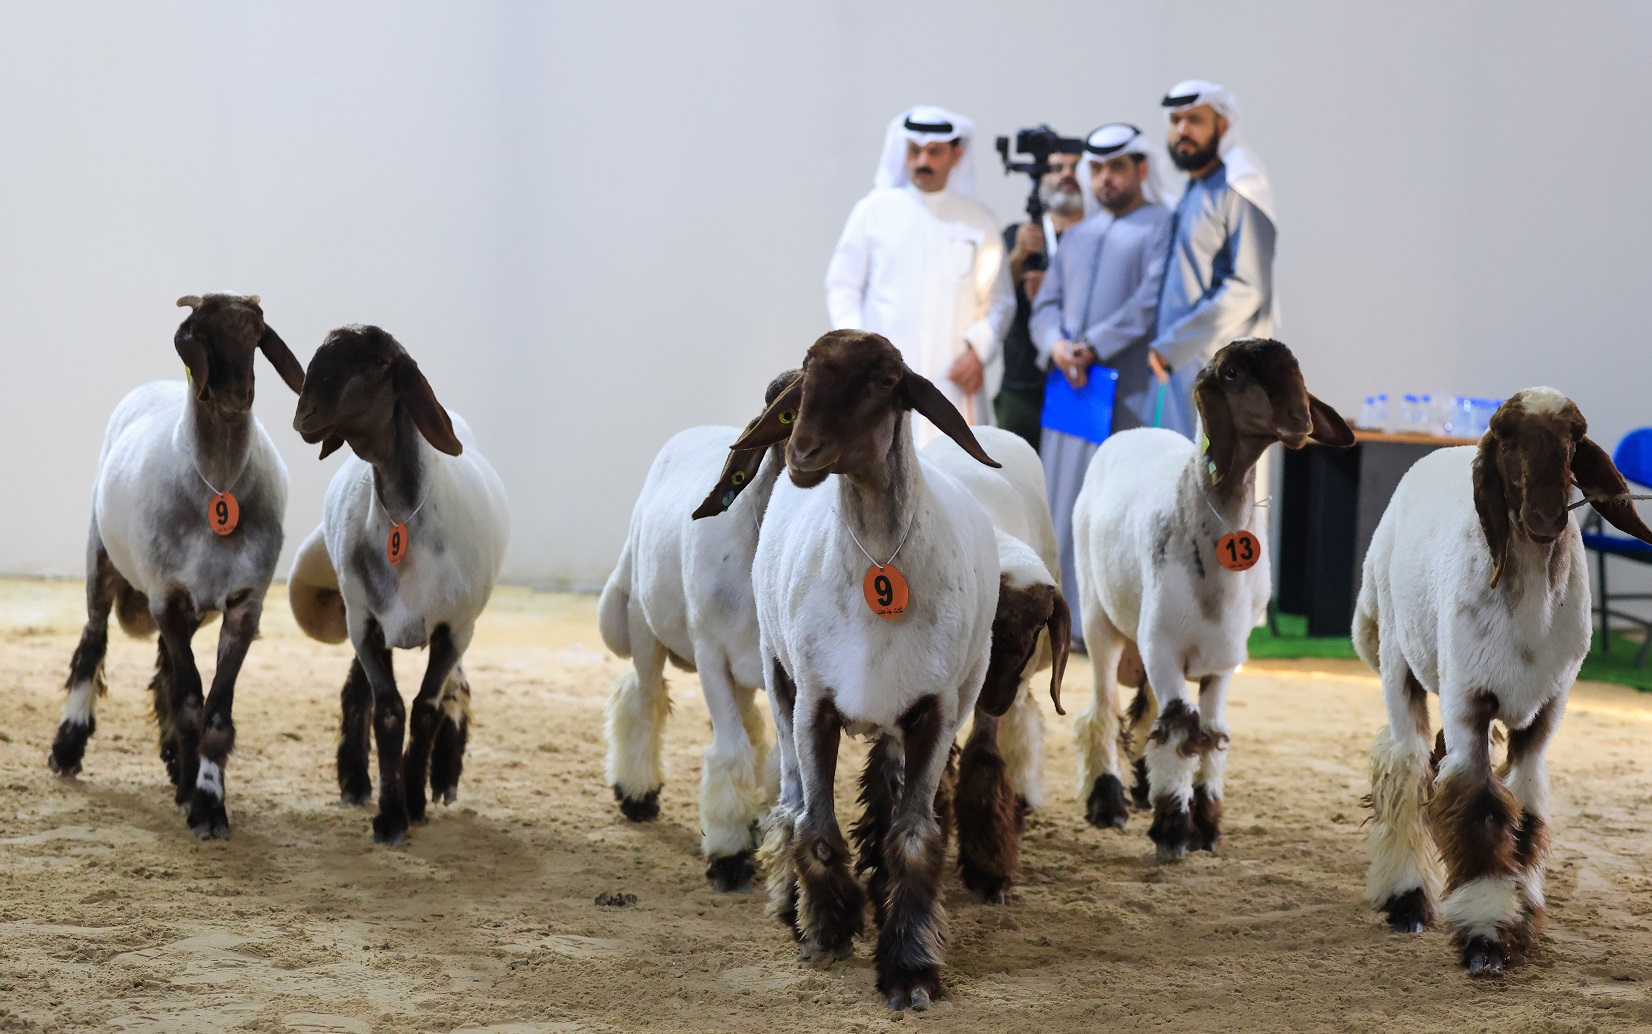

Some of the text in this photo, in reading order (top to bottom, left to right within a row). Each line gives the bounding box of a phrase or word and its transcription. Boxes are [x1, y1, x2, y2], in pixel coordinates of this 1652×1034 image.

[216, 501, 228, 525] 9
[392, 532, 400, 556] 9
[1226, 537, 1253, 561] 13
[874, 575, 893, 606] 9
